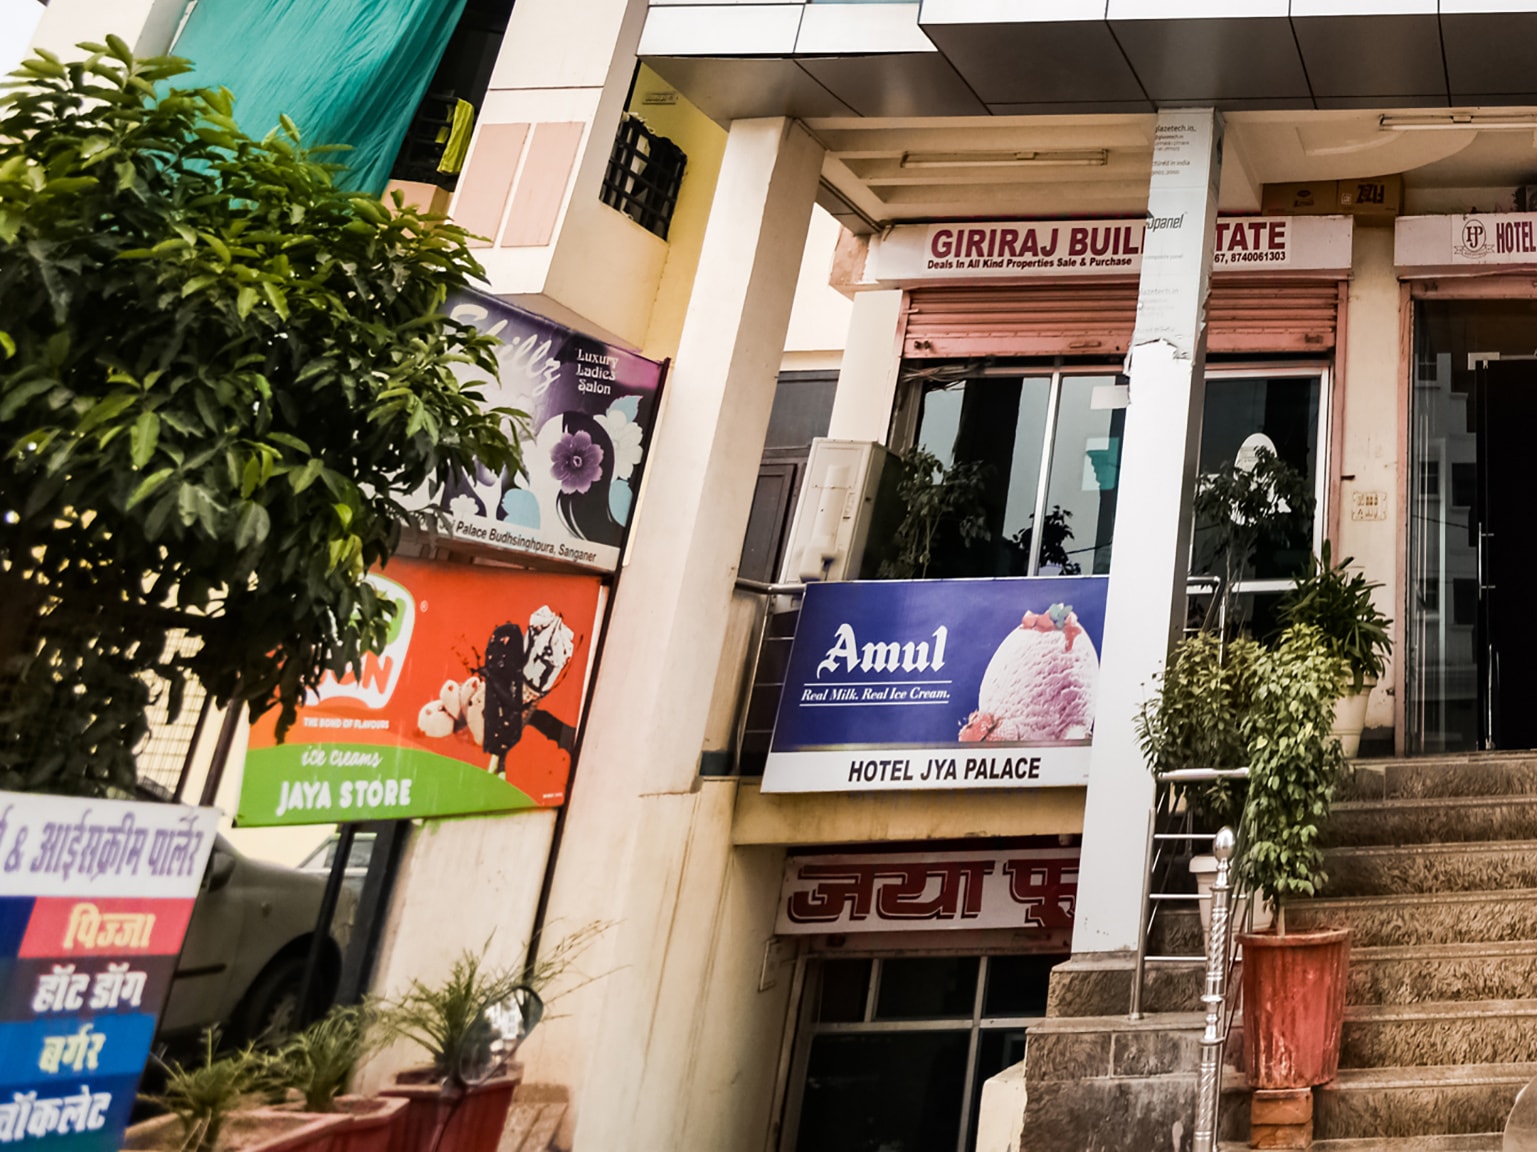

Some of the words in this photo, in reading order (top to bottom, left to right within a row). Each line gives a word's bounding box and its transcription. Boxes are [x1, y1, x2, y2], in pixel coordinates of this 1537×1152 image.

[931, 228, 1059, 258] GIRIRAJ
[1068, 226, 1145, 256] BUIL
[1216, 222, 1286, 251] TATE
[1496, 221, 1536, 253] HOTEL
[928, 259, 953, 269] Deals
[956, 259, 965, 268] In
[967, 259, 980, 268] All
[982, 258, 1003, 268] Kind
[1006, 257, 1054, 270] Properties
[1057, 256, 1077, 267] Sale
[1079, 257, 1086, 266] &
[1089, 256, 1132, 267] Purchase
[1214, 252, 1228, 264] 67,
[575, 363, 617, 381] Ladies
[577, 348, 619, 369] Luxury
[577, 378, 611, 395] Salon
[456, 521, 487, 539] Palace
[558, 543, 597, 563] Sanganer
[816, 623, 948, 680] Amul
[800, 688, 827, 702] Real
[829, 687, 860, 702] Milk.
[862, 687, 887, 701] Real
[889, 687, 907, 700] Ice
[909, 686, 951, 700] Cream.
[848, 759, 913, 782] HOTEL
[920, 758, 957, 781] JYA
[964, 757, 1041, 780] PALACE
[276, 779, 332, 816] JAYA
[339, 778, 411, 808] STORE
[788, 859, 996, 923] जया
[63, 902, 156, 949] पिज्जा
[32, 963, 90, 1013] हॉट
[90, 961, 147, 1010] डॉग
[39, 1023, 106, 1074] बर्गर
